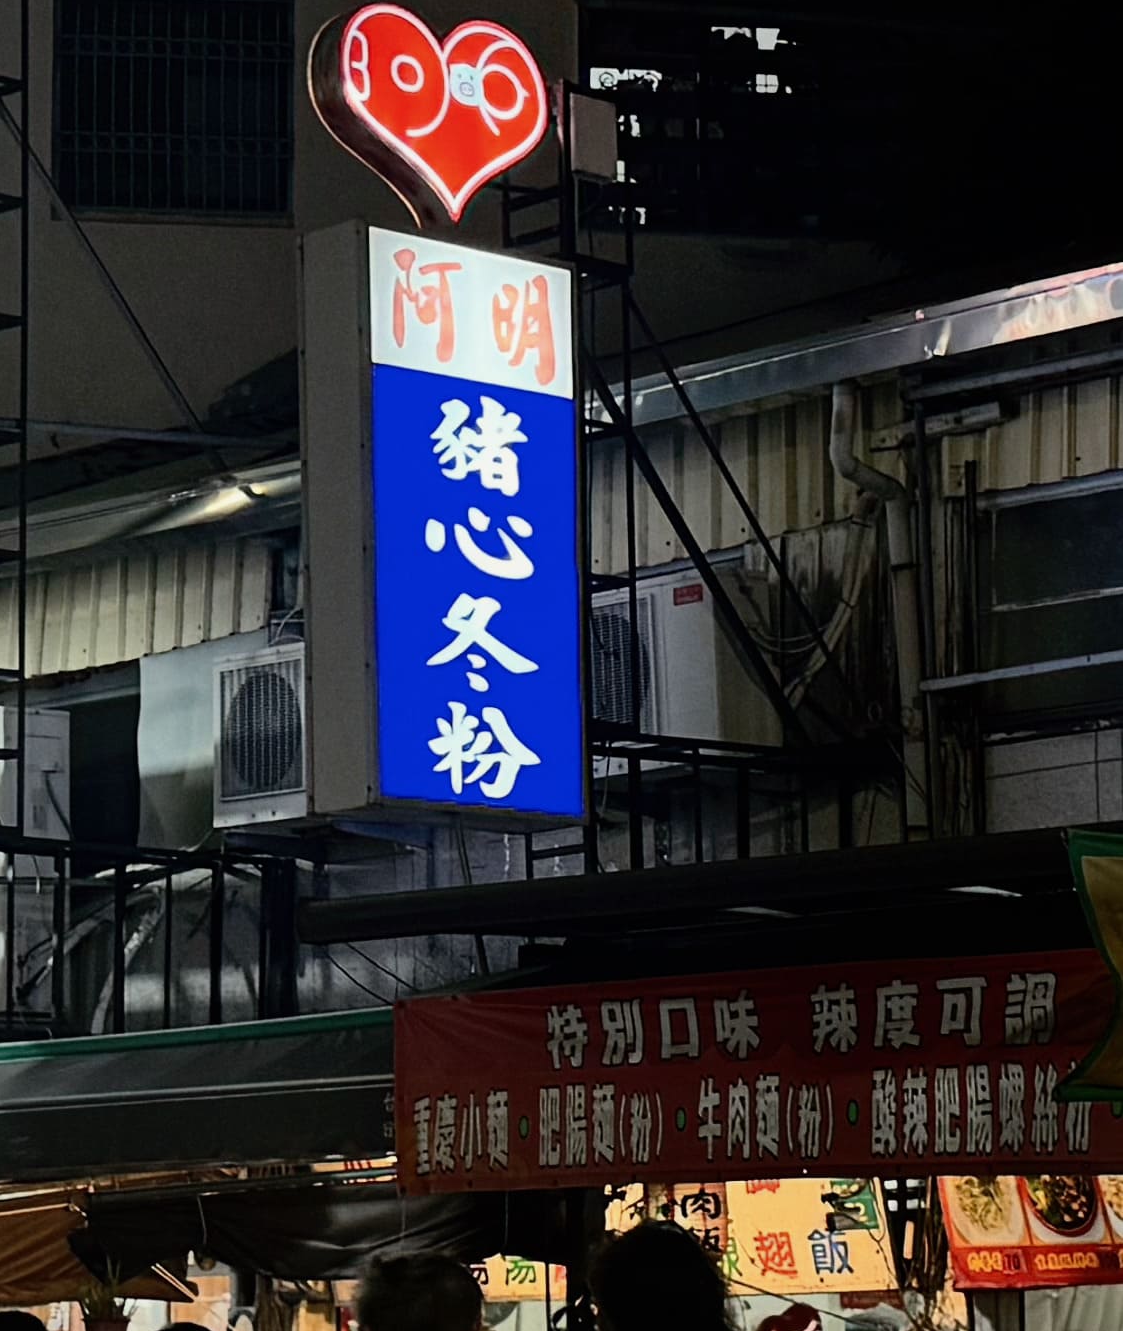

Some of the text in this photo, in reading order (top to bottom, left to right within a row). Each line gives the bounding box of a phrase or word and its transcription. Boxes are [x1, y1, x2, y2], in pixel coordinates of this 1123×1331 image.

[391, 247, 558, 386] 阿明
[425, 397, 541, 798] 豬心冬粉
[547, 972, 1057, 1068] 特別口味 辣度可調
